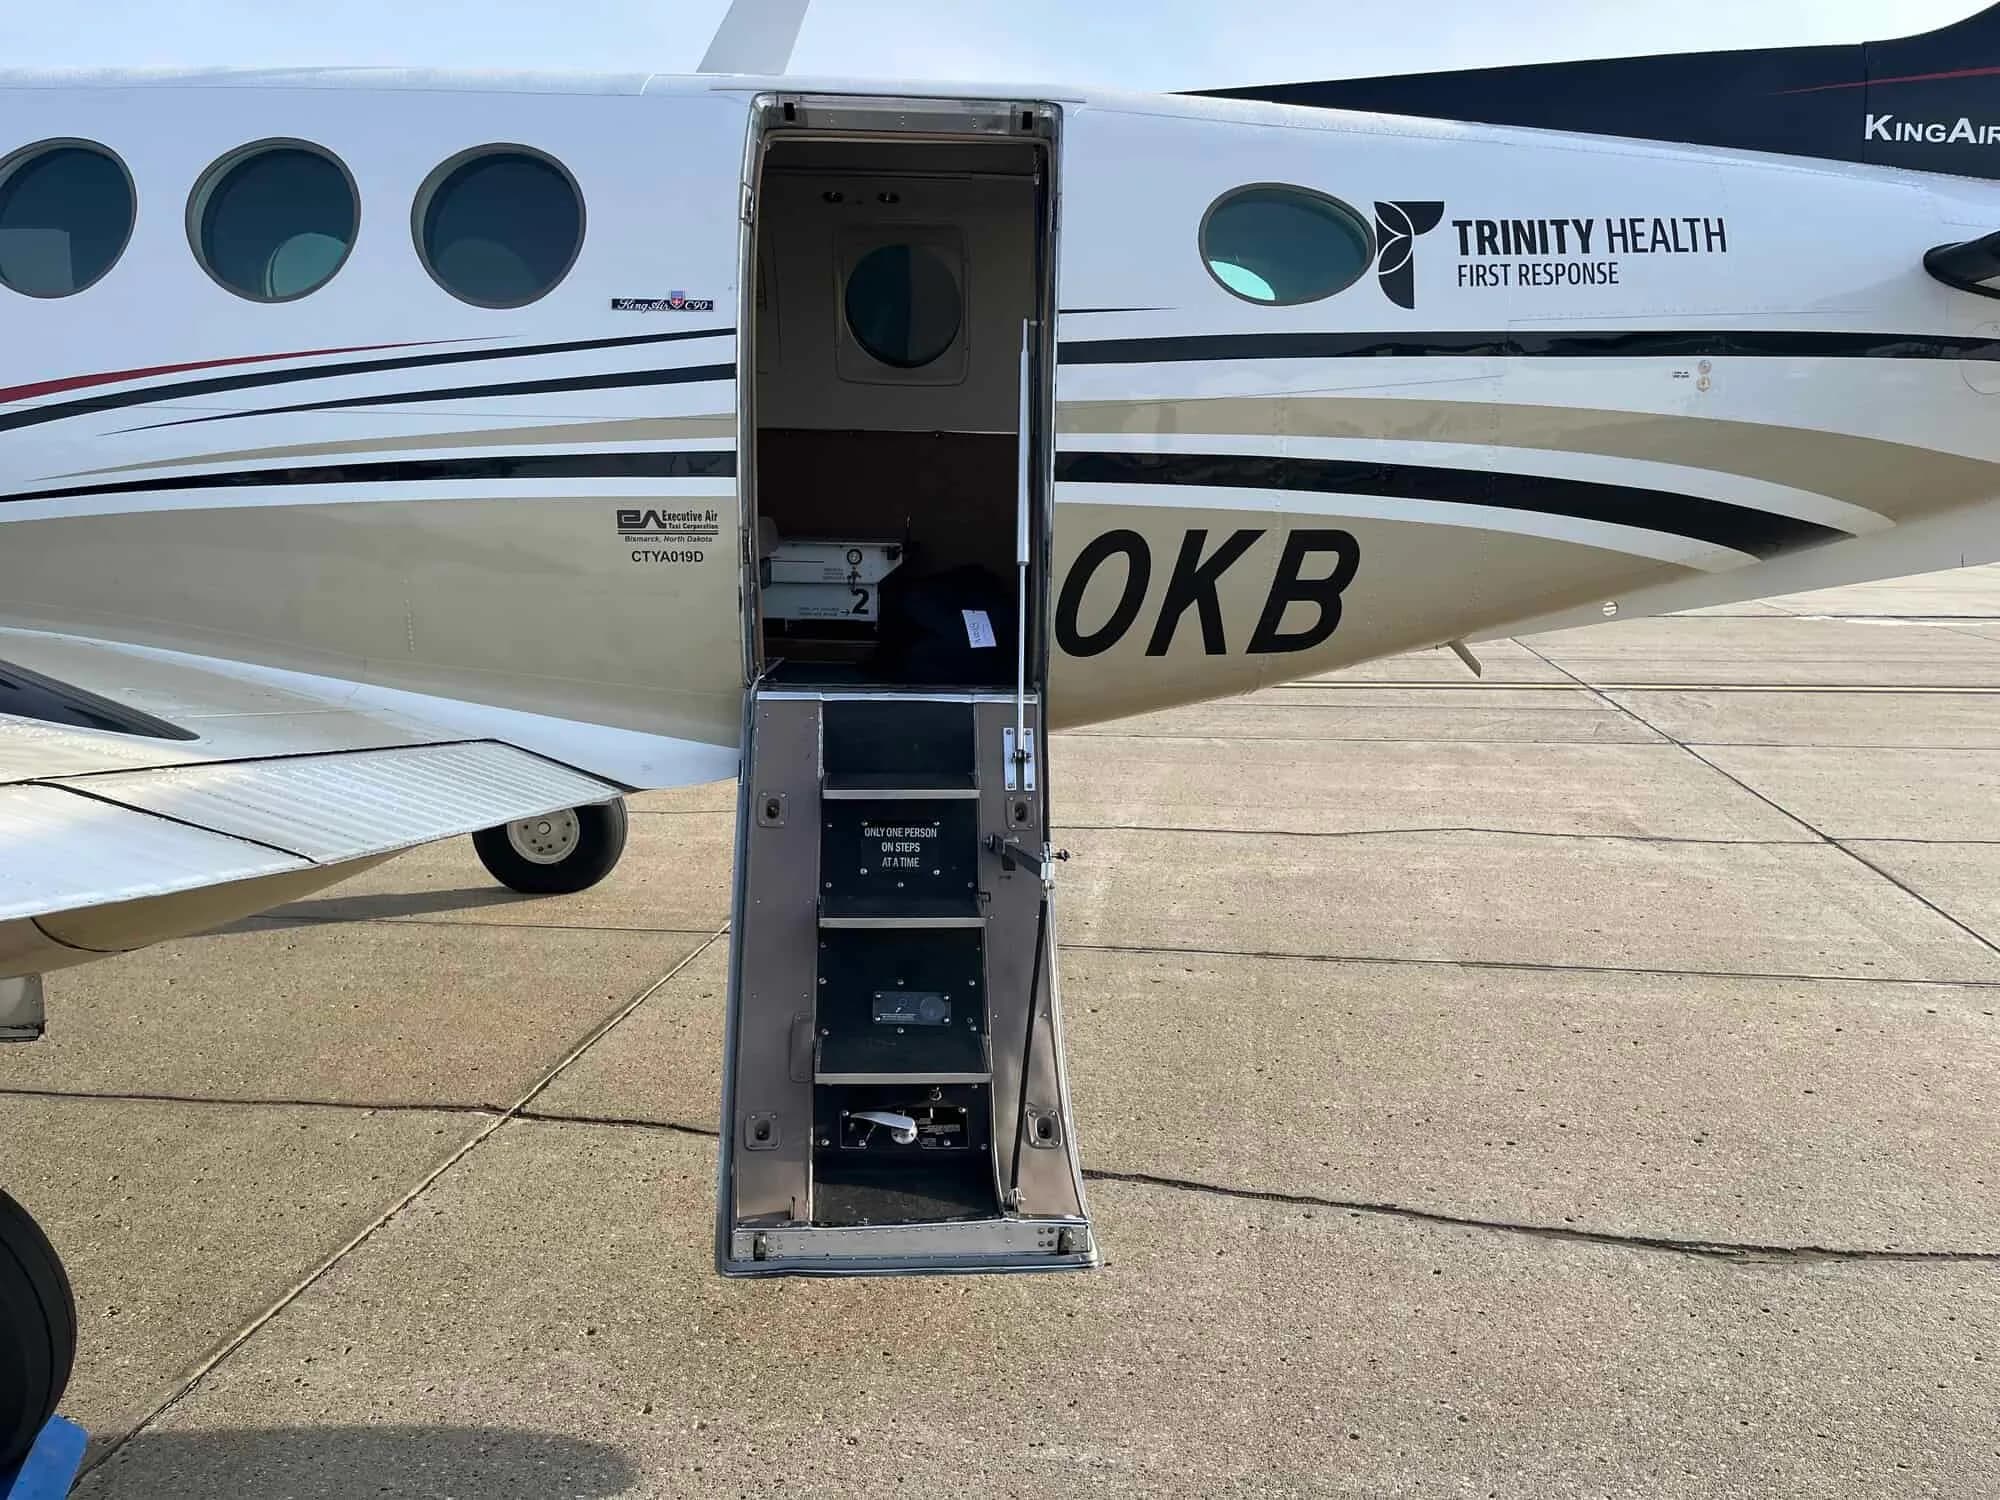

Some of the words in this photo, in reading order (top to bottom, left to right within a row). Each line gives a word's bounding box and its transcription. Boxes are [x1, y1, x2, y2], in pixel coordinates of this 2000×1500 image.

[1452, 218, 1594, 256] TRINITY
[1605, 217, 1727, 253] HEALTH
[1457, 263, 1511, 287] FIRST
[1518, 262, 1619, 286] RESPONSE
[662, 509, 702, 521] Executive
[705, 509, 718, 521] Air
[631, 550, 704, 562] CTYA019D
[852, 588, 869, 614] 2
[864, 827, 885, 838] ONLY
[886, 827, 904, 838] ONE
[904, 827, 937, 838] PERSON
[881, 842, 894, 852] ON
[895, 842, 920, 853] STEPS
[881, 856, 892, 867] AT
[892, 856, 899, 867] A
[900, 857, 920, 868] TIME
